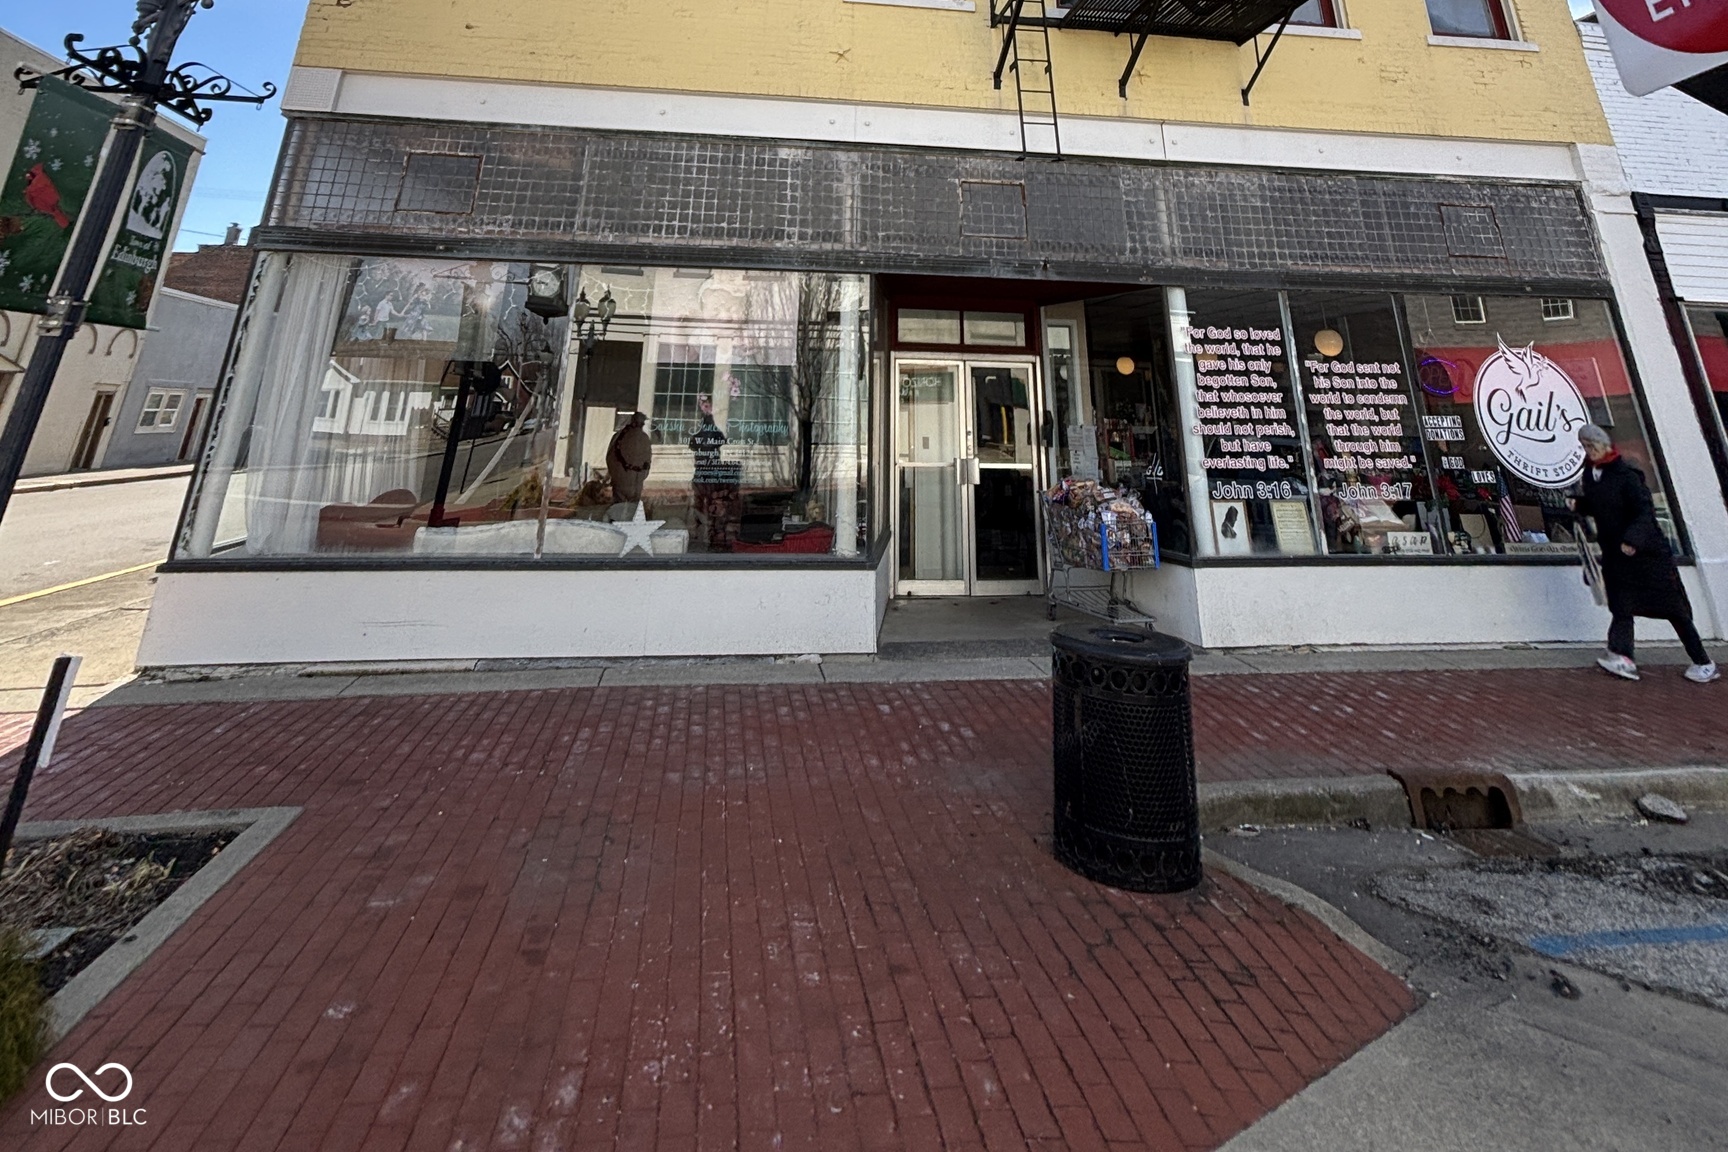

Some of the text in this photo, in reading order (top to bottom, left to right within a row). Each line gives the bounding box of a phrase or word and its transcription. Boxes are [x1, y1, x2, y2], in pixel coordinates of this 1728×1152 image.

[1206, 326, 1232, 339] God
[1233, 330, 1248, 340] so
[1249, 327, 1281, 340] loved
[1184, 342, 1282, 356] the world, that he
[1198, 358, 1272, 373] gave his only
[1304, 360, 1402, 374] "For God sent not
[1197, 373, 1277, 389] begotten Son,
[1313, 376, 1398, 389] his Son into the
[1195, 389, 1283, 402] that whosoever
[1308, 392, 1408, 405] world to condemn
[1197, 406, 1286, 419] believeth in him
[1323, 407, 1400, 422] the world, but
[1487, 388, 1586, 445] Gail's
[1423, 416, 1462, 427] ACCEPTING
[1193, 422, 1295, 437] should not perish,
[1326, 423, 1403, 436] that the world
[1426, 429, 1465, 440] DONATIONS
[707, 437, 725, 445] Main
[1220, 439, 1272, 452] but have
[1333, 439, 1402, 454] through him
[1202, 455, 1294, 472] everlasting life."
[1323, 455, 1416, 472] might be saved."
[1507, 450, 1582, 477] THRIFT STORE
[1472, 471, 1496, 483] LOVES
[1212, 481, 1292, 499] John 3:16
[1339, 482, 1412, 500] John 3:17
